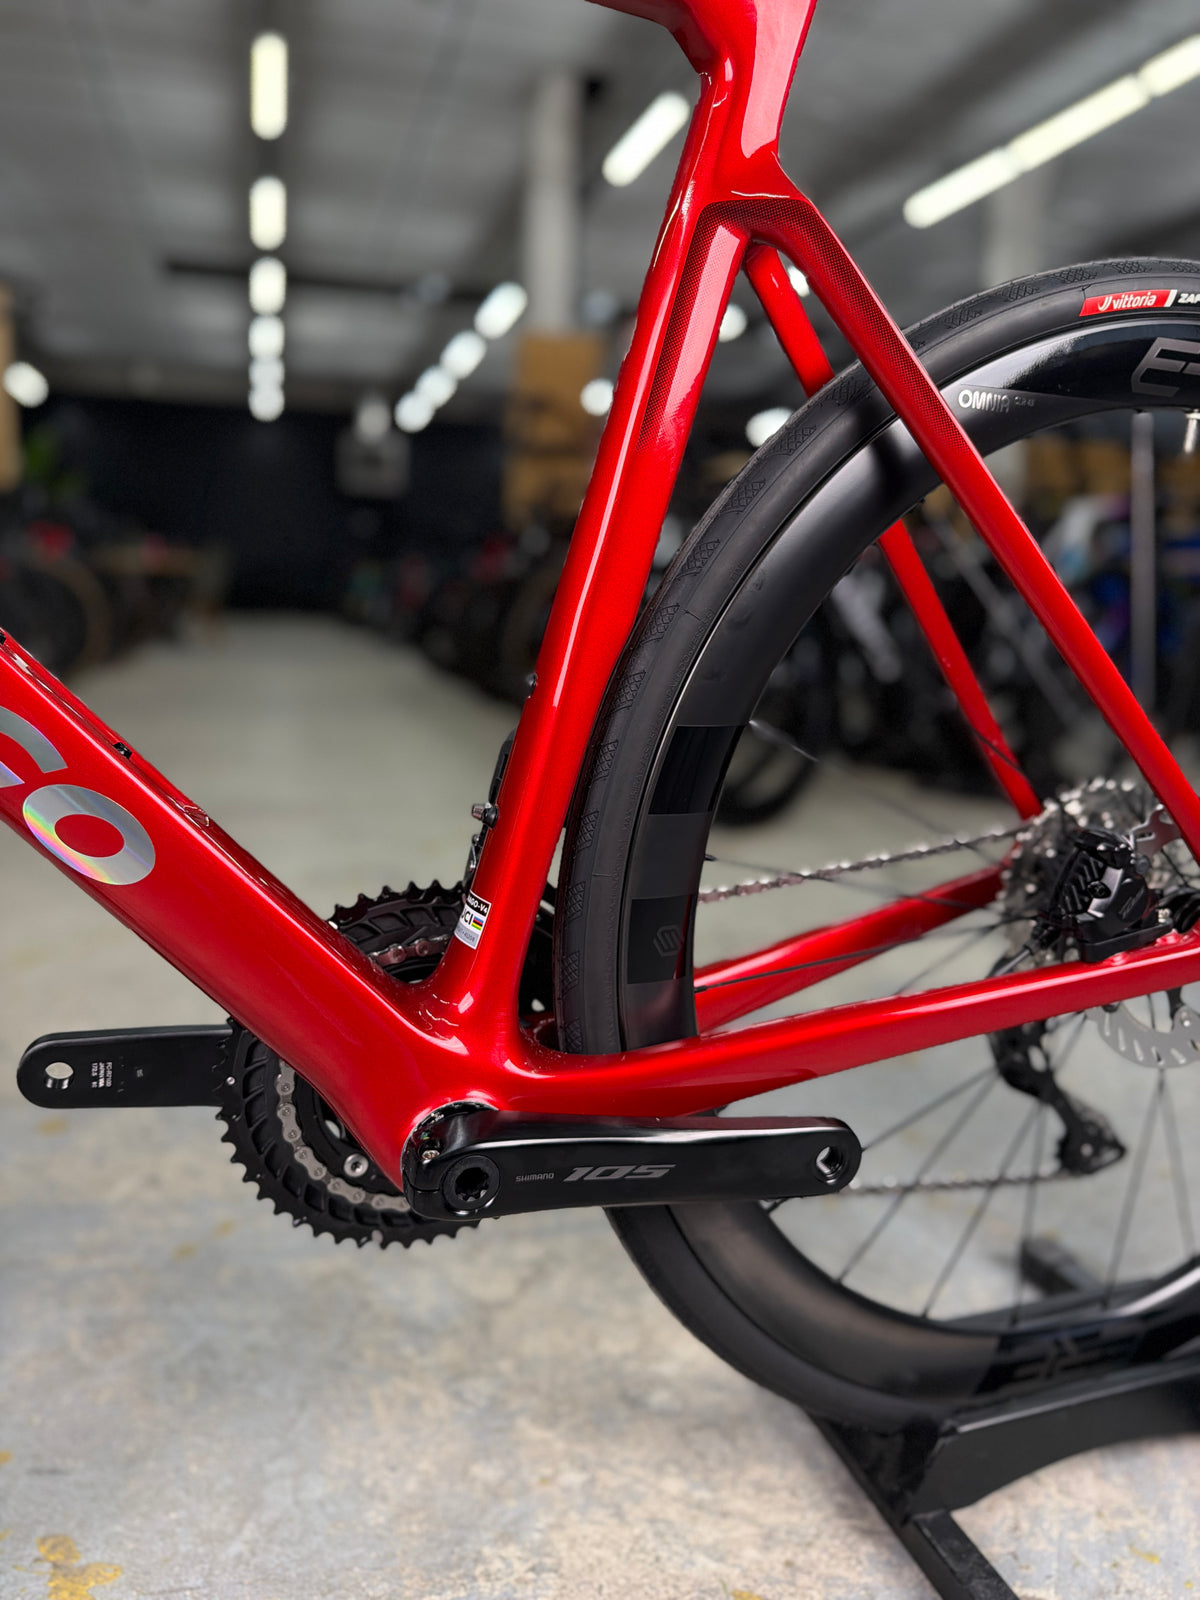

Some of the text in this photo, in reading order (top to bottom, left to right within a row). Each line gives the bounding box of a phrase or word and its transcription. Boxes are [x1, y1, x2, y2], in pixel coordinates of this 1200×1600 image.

[1112, 292, 1157, 310] vittoria
[958, 389, 1010, 413] OMNIA
[515, 1164, 676, 1182] SHIMANO 105
